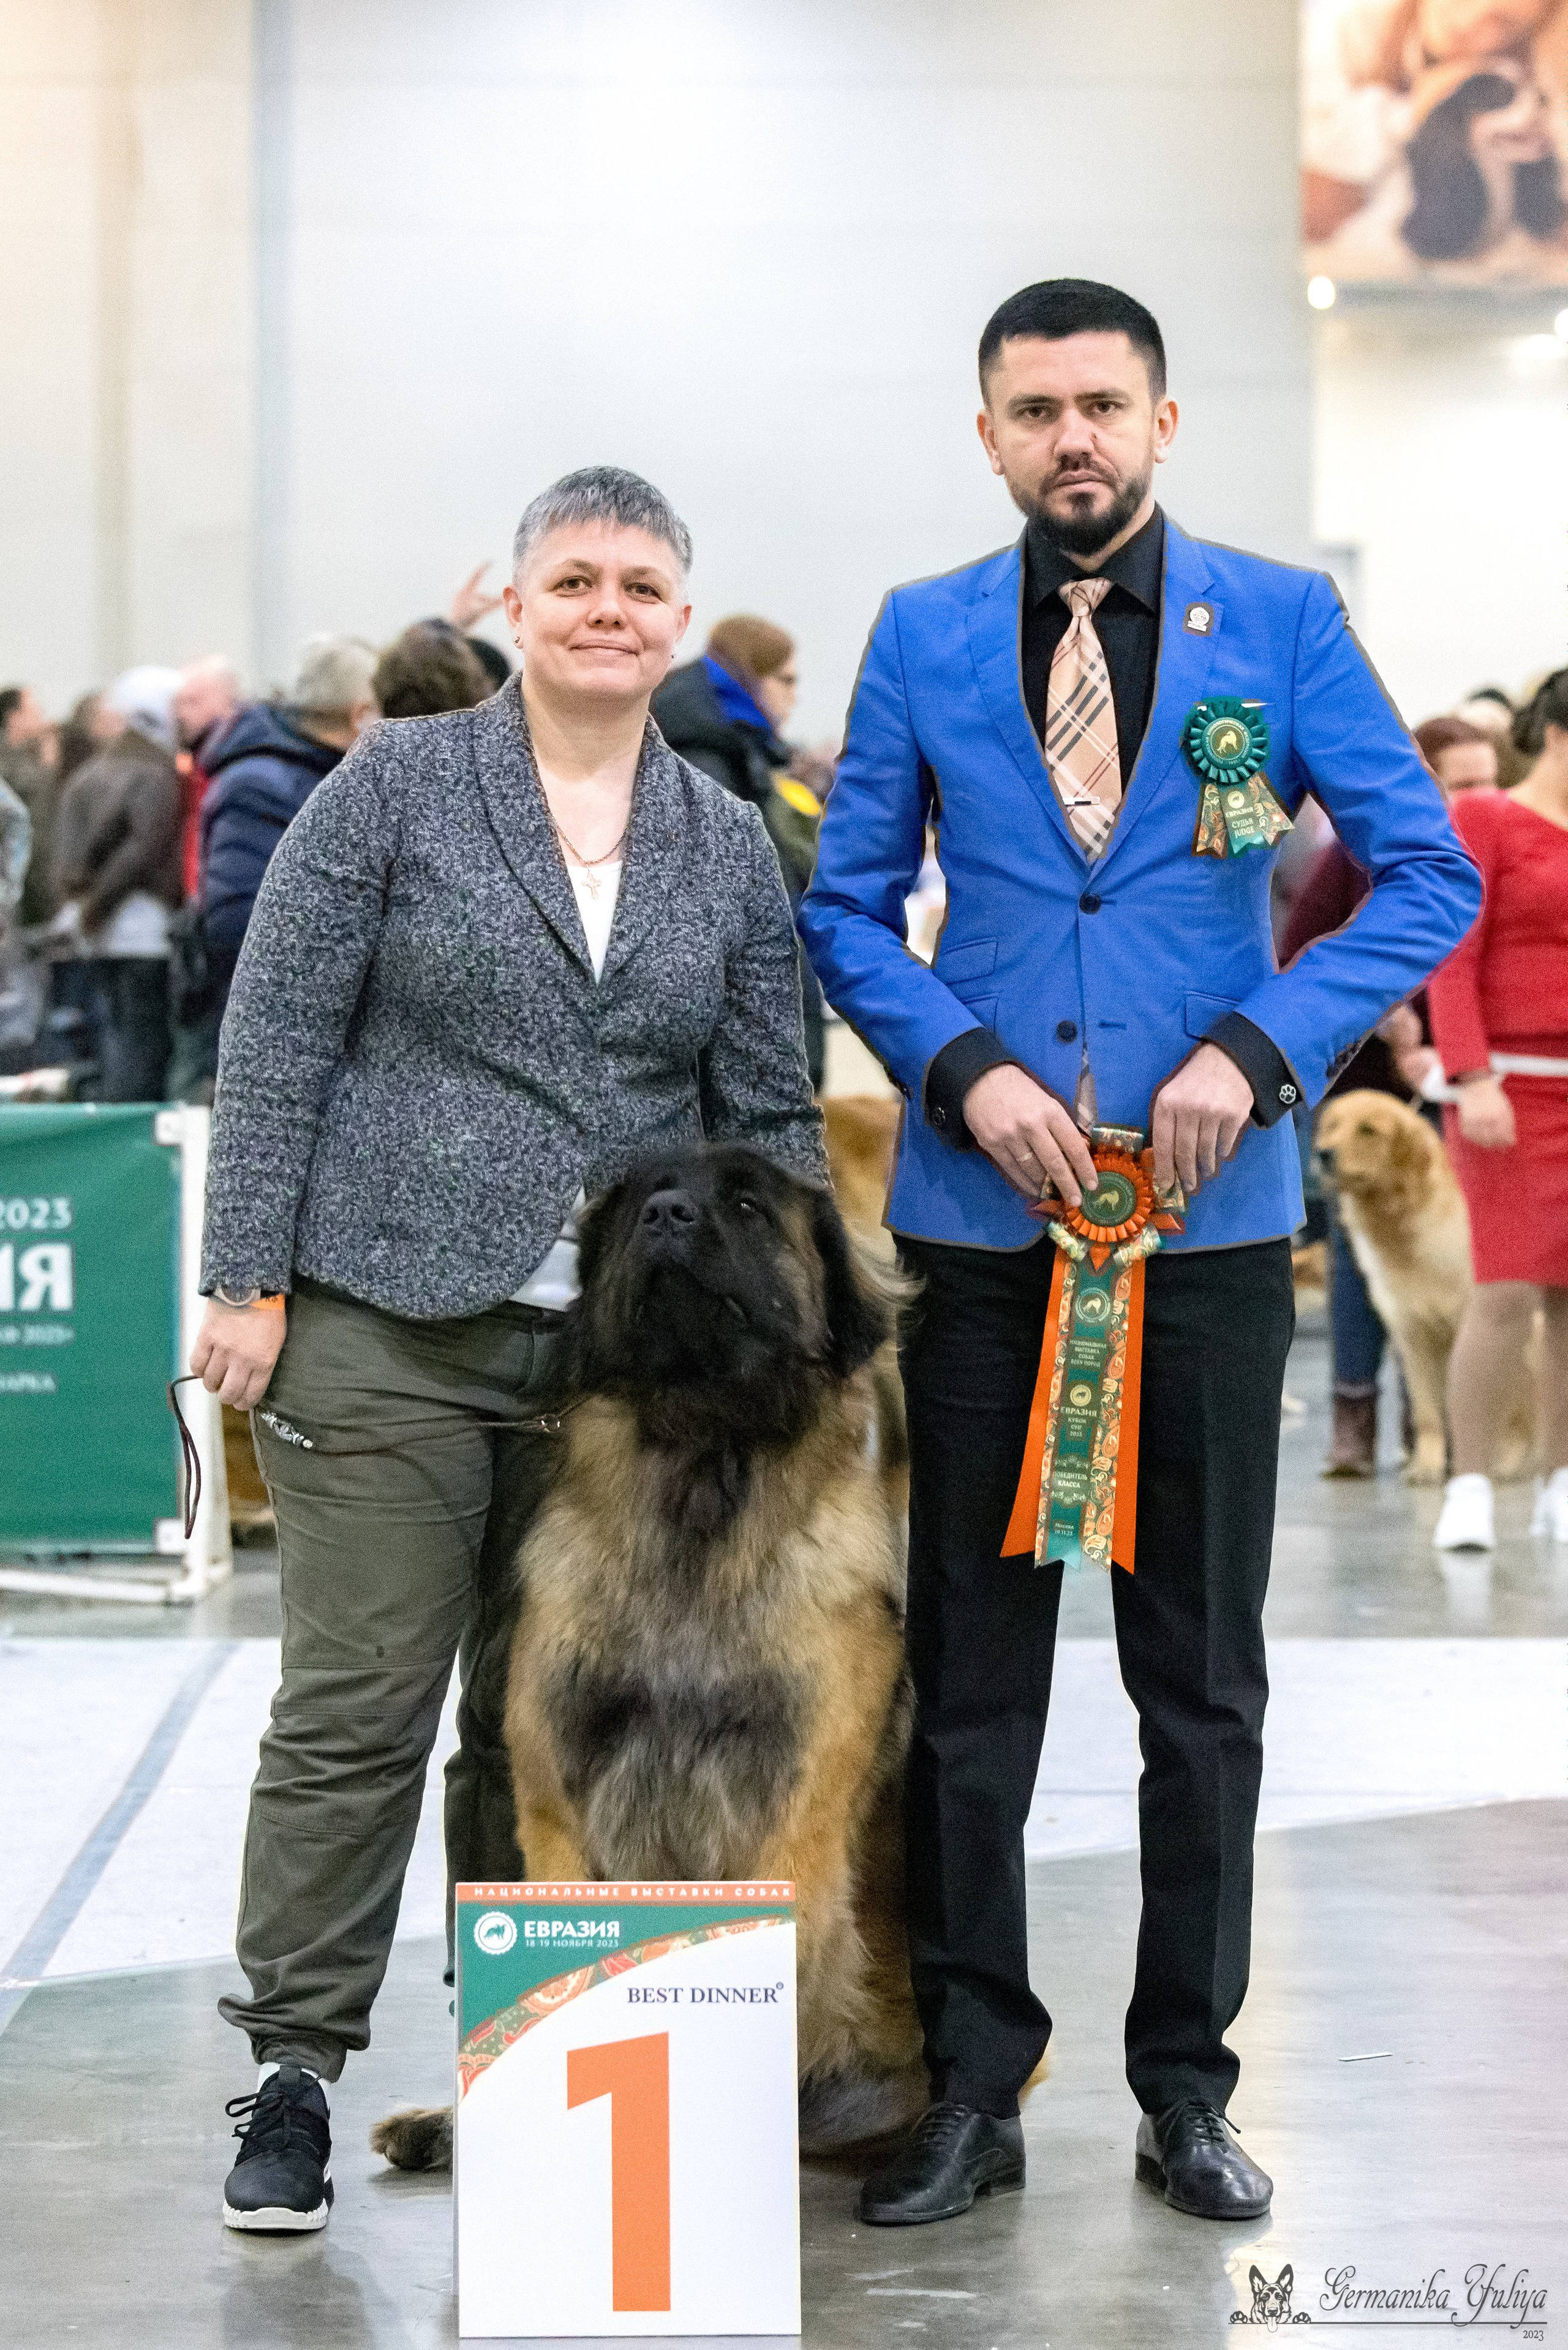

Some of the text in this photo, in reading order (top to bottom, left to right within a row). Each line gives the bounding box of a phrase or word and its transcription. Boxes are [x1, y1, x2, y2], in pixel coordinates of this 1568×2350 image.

[1225, 807, 1254, 818] ЕВРАЗИЯ
[1232, 818, 1254, 828] СУДЬЯ
[1234, 826, 1255, 839] JUDGE
[0, 1197, 72, 1229] 023
[1061, 1407, 1097, 1417] ЕВРАЗИЯ
[1058, 1480, 1080, 1488] КЛАССА
[474, 1887, 790, 1897] НАЦИОНАЛЬНЫЕ ВЫСТАВКИ СОБАК
[524, 1921, 620, 1938] ЕВРАЗИЯ
[552, 1939, 594, 1948] НОЯБРЯ
[597, 1939, 619, 1948] 2023
[627, 1987, 684, 2003] BEST
[567, 2031, 671, 2311] 1
